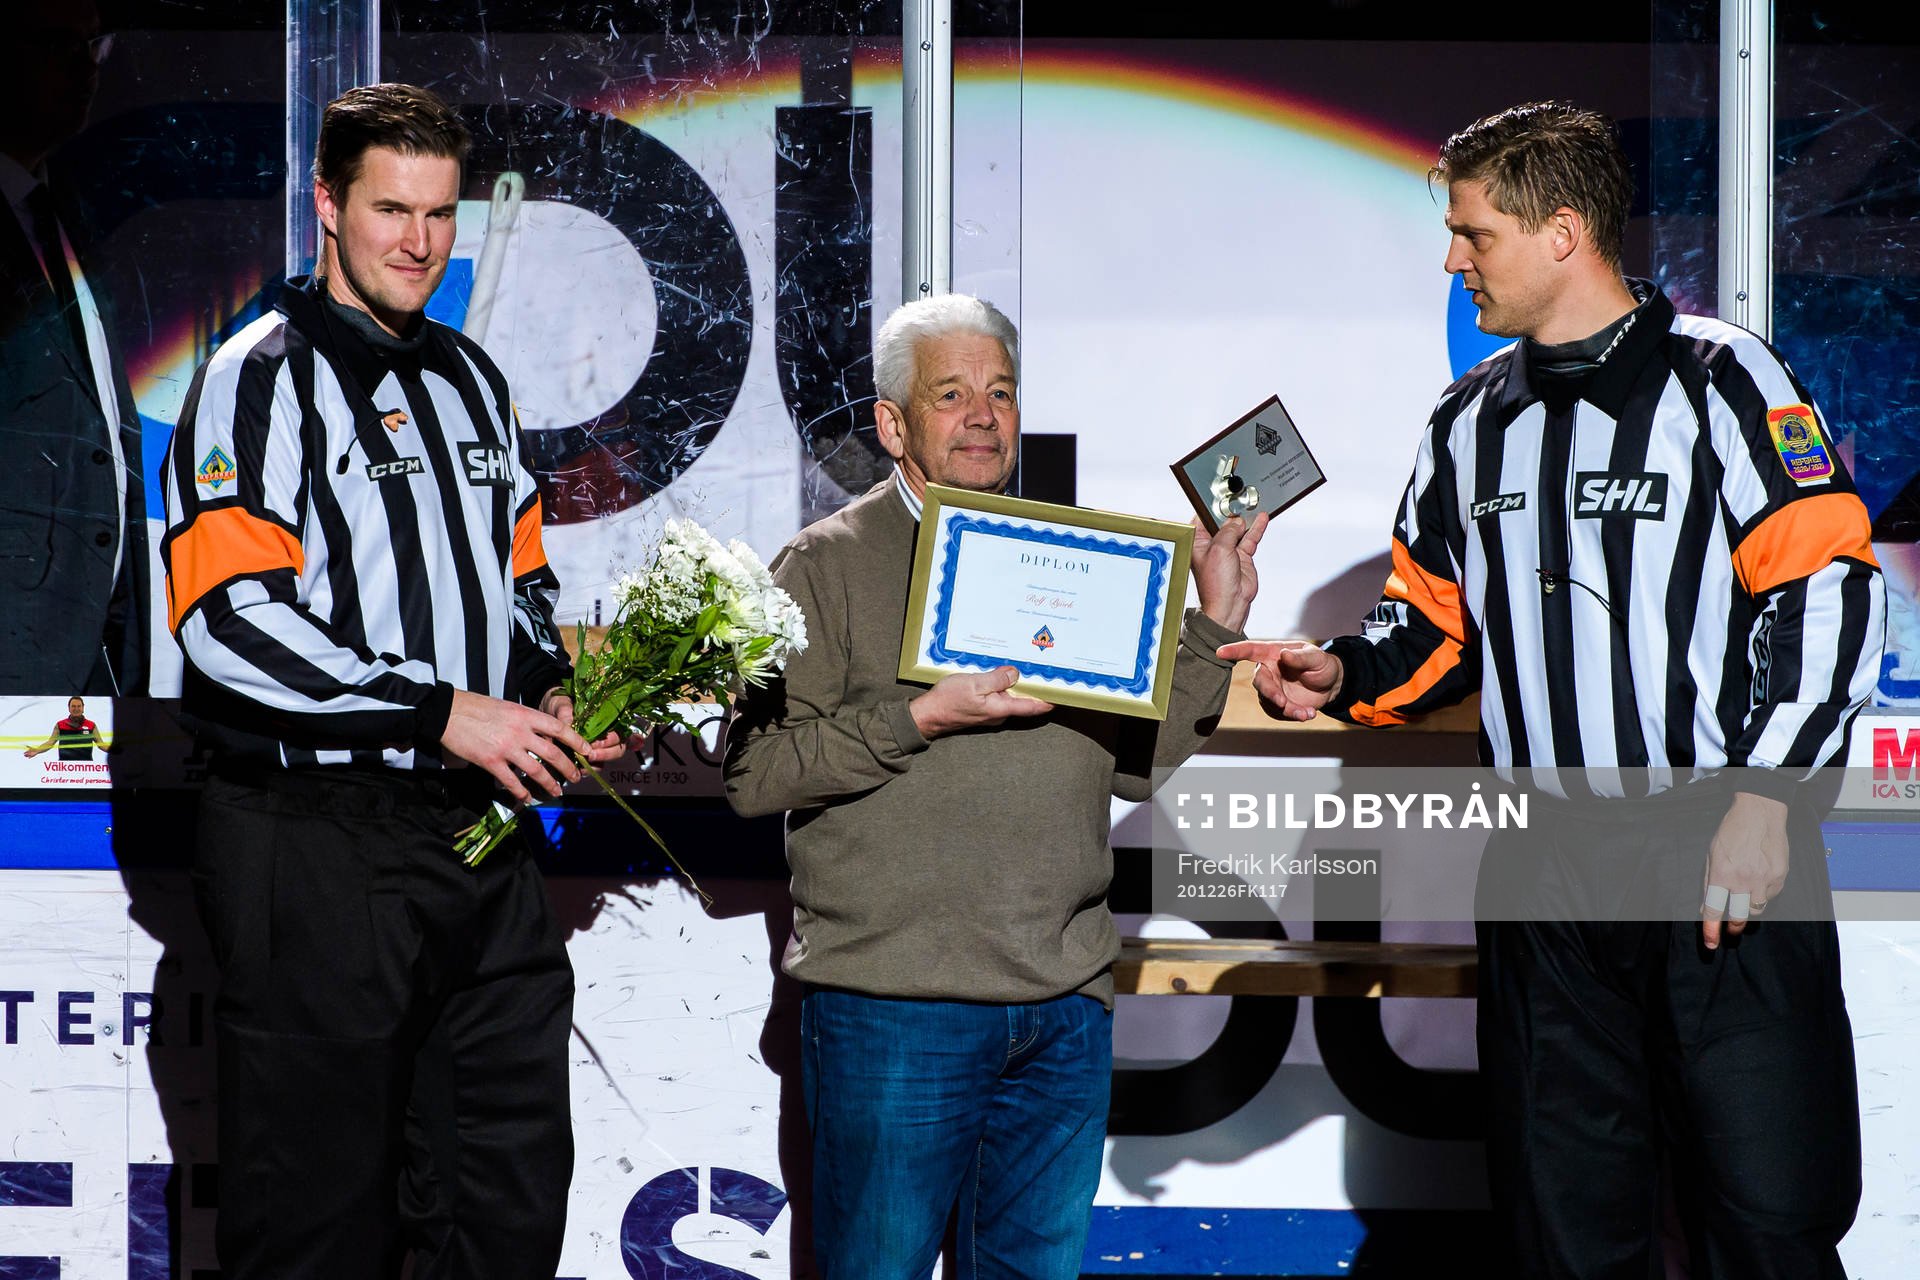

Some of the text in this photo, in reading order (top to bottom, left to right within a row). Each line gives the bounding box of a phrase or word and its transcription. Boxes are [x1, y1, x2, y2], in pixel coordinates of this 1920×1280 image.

[369, 460, 420, 479] CCM
[1578, 479, 1662, 513] SHL
[1473, 495, 1523, 517] CCM
[1021, 553, 1089, 574] DIPLOM
[44, 761, 109, 772] Välkommen
[609, 772, 687, 784] SINCE 1930
[1873, 783, 1900, 798] ICA
